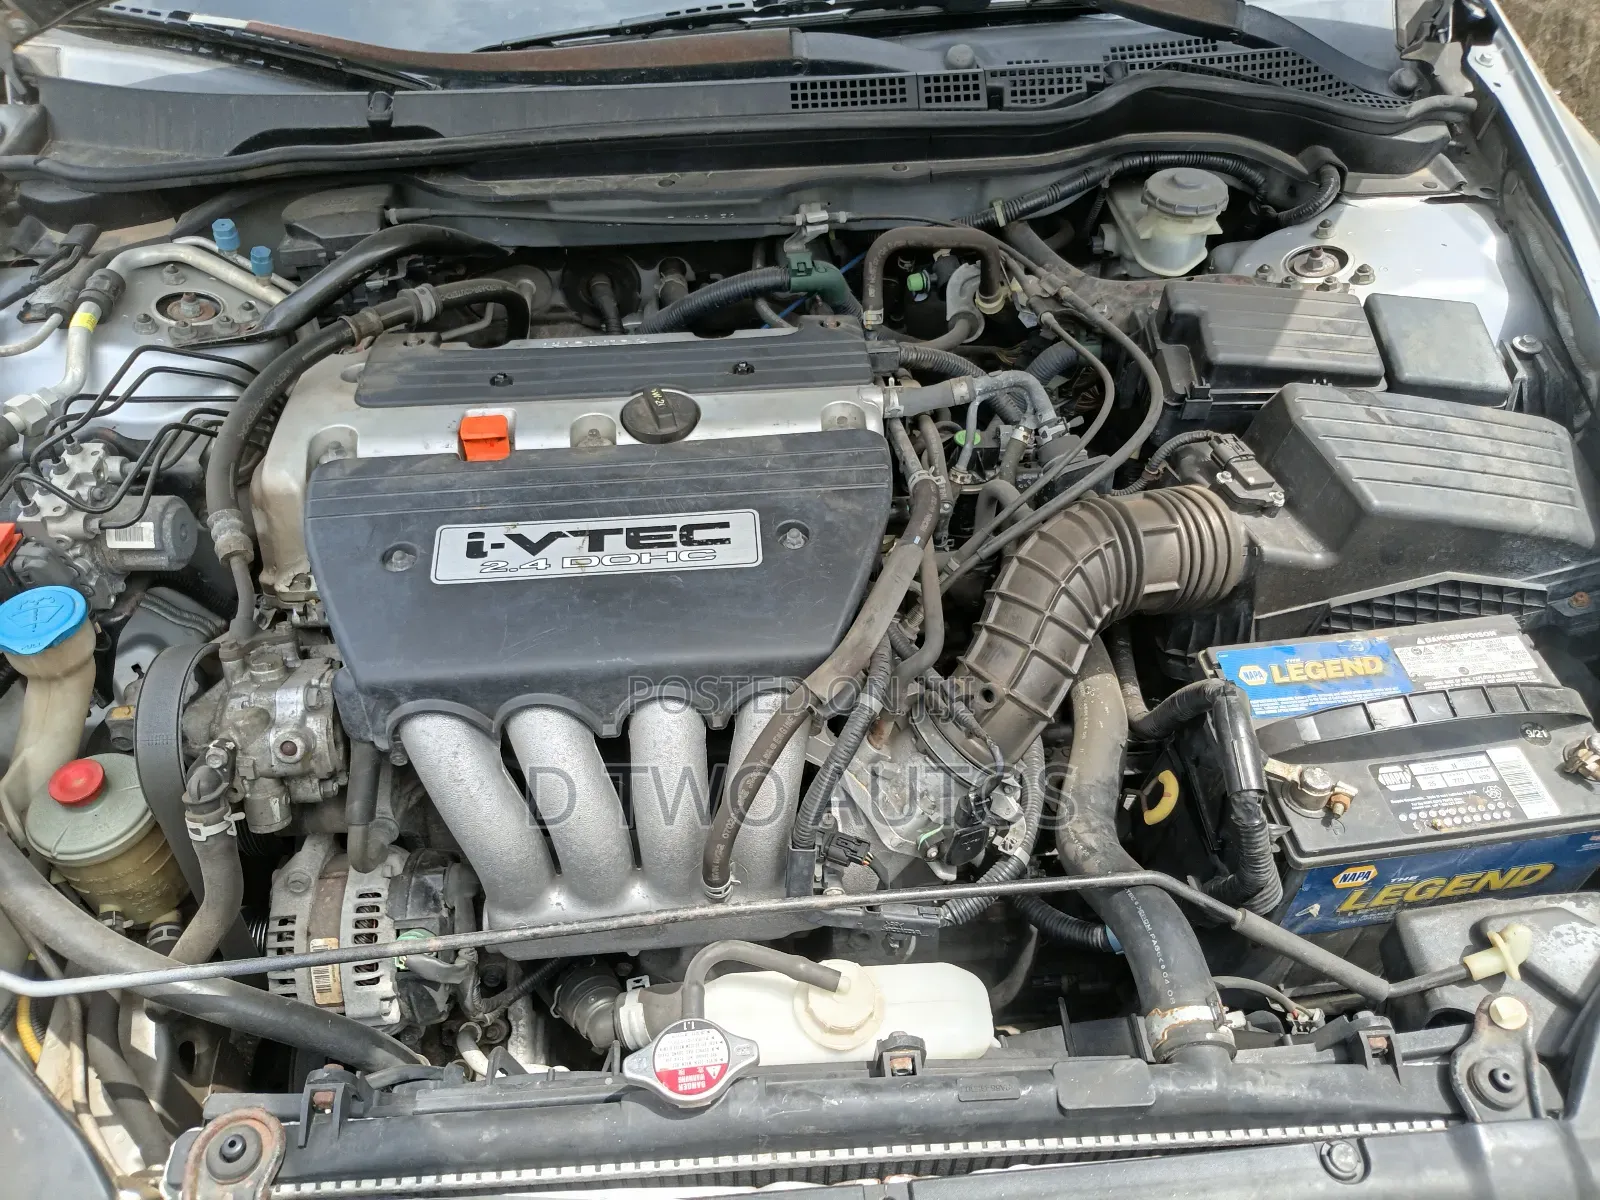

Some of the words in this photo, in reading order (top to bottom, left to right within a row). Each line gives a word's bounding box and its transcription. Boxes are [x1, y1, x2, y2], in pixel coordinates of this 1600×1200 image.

[465, 521, 731, 559] i-VTEC
[480, 557, 551, 575] 2.4
[562, 548, 717, 570] DOHC
[1425, 630, 1497, 644] DANGER/POISON
[1243, 670, 1264, 681] NAPA
[1269, 656, 1383, 684] LEGEND
[1525, 729, 1548, 738] 9/21
[1380, 770, 1411, 787] NAPA
[1338, 869, 1372, 885] NAPA
[1391, 875, 1419, 883] THE
[1336, 862, 1555, 912] LEGEND
[683, 1020, 695, 1031] 1.1
[677, 1073, 706, 1083] WARNING
[678, 1081, 706, 1091] DANGER
